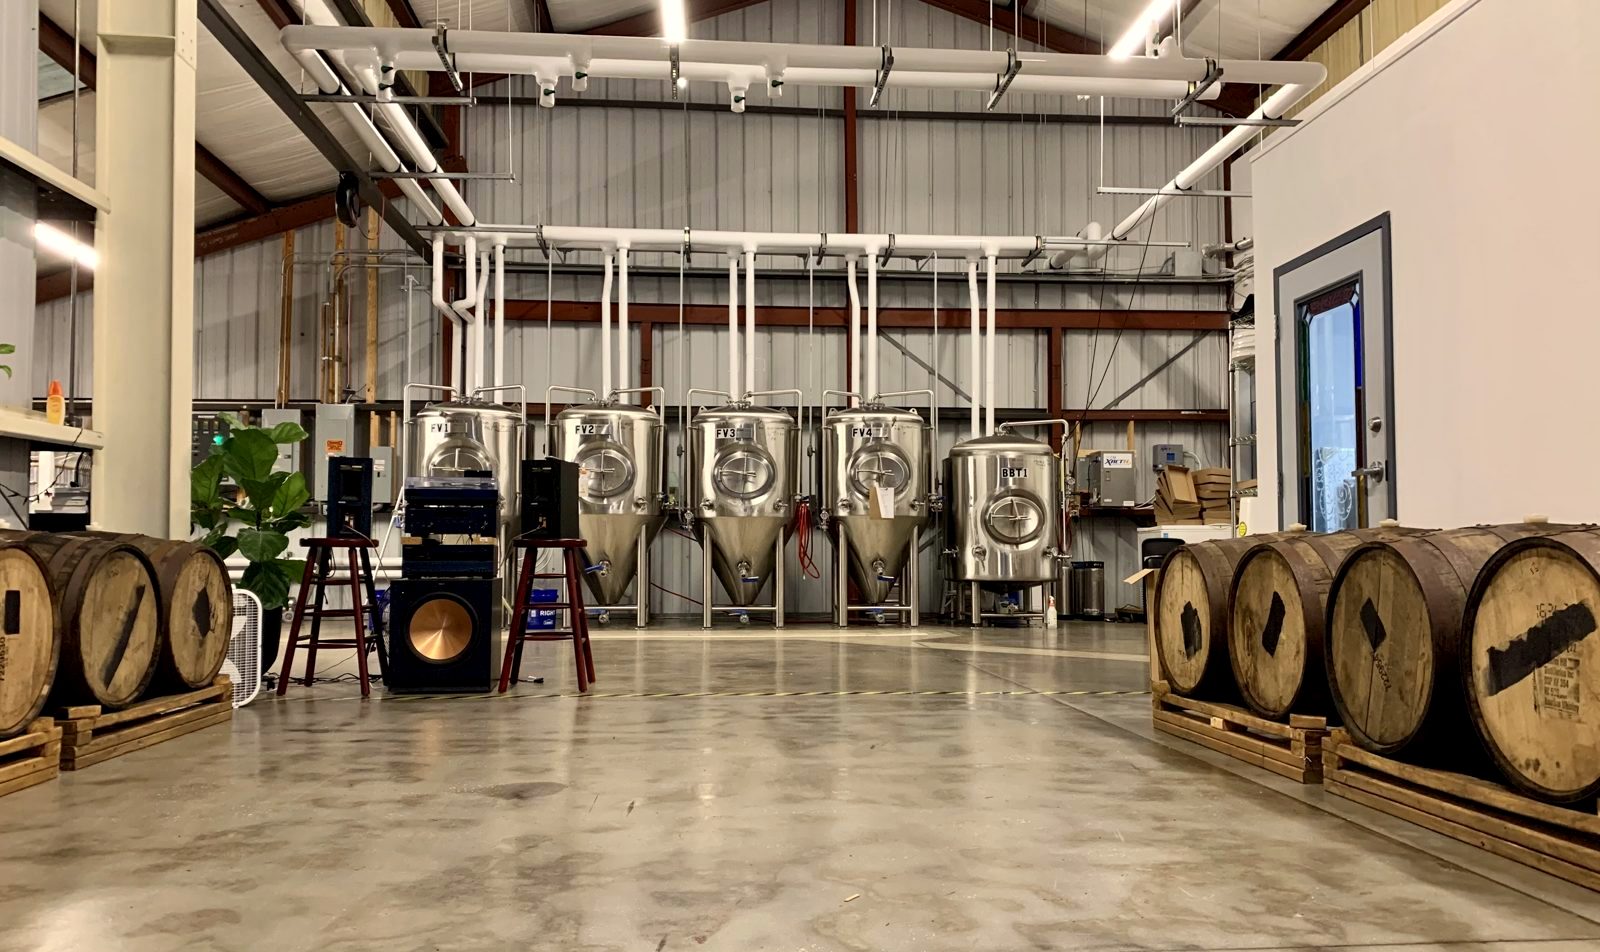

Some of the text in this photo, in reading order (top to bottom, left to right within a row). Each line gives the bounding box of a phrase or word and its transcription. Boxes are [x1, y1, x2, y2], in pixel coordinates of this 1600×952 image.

[431, 423, 449, 433] FV1
[575, 424, 595, 434] FV2
[716, 428, 736, 438] FV3
[852, 428, 872, 437] FV4
[1002, 468, 1028, 478] BBT1
